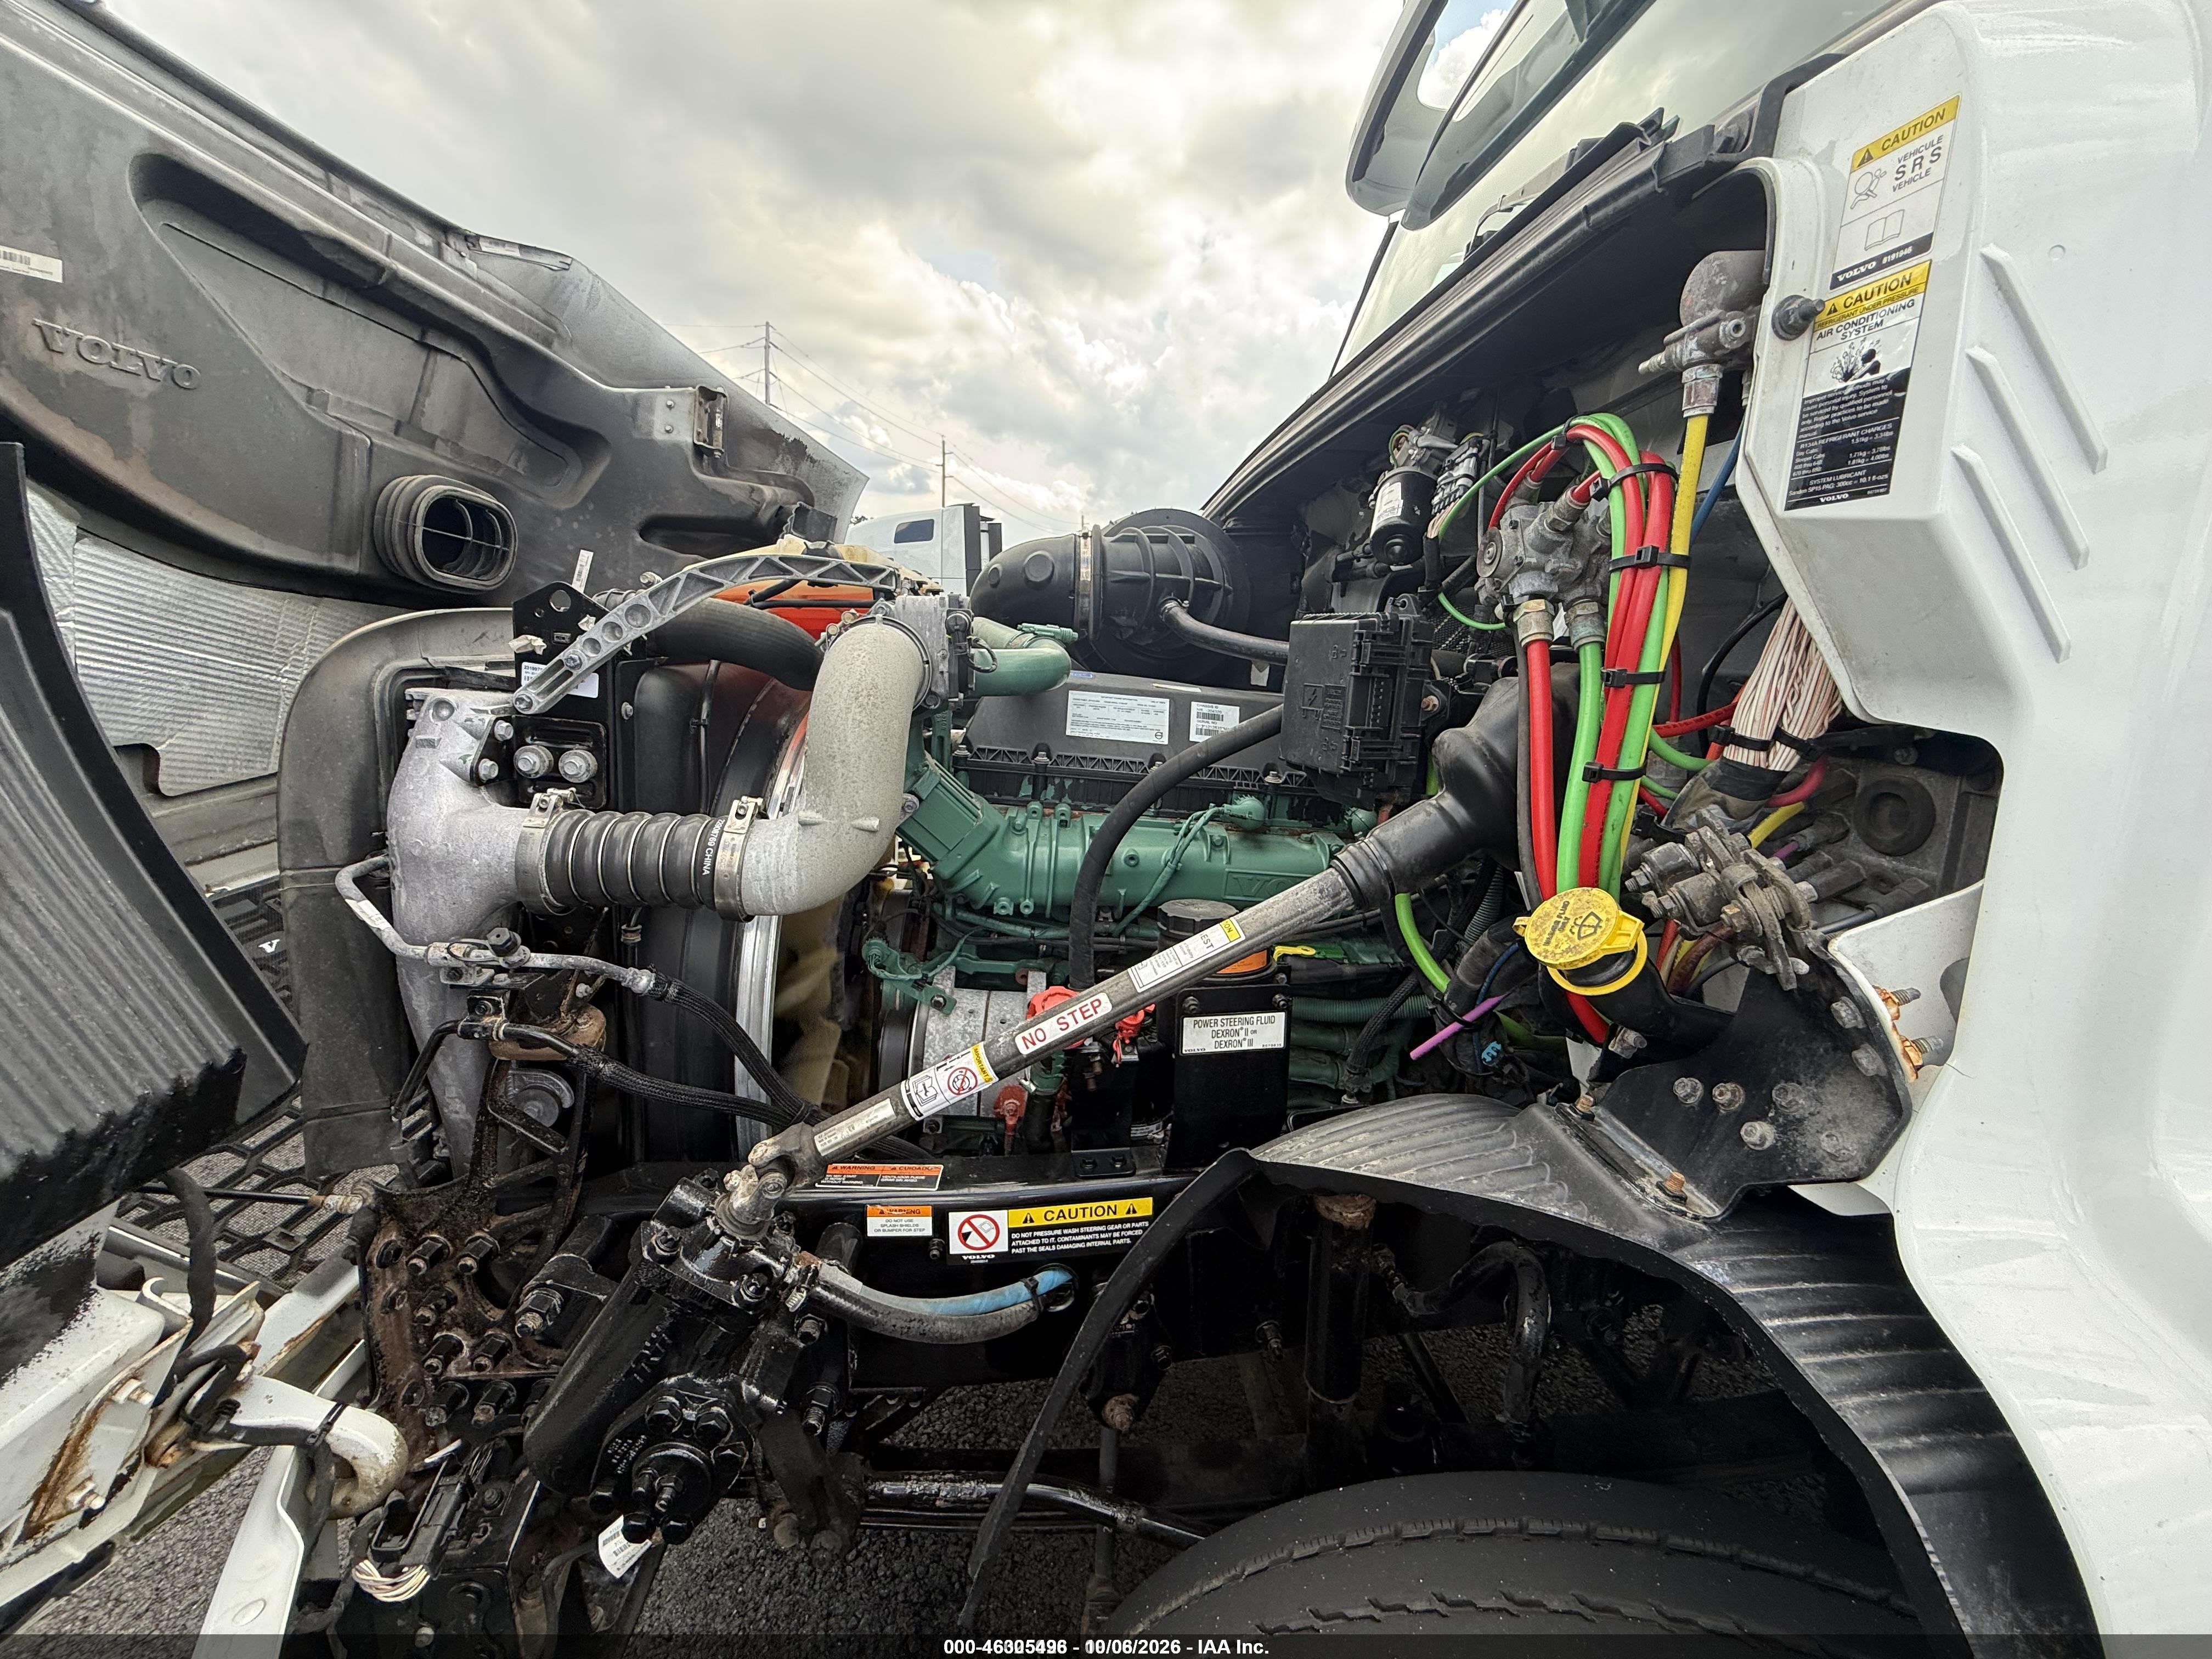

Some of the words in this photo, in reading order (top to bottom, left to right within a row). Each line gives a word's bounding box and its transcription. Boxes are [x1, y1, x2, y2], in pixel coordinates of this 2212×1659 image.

[1882, 109, 1945, 152] CAUTION
[1898, 135, 1944, 163] VEHICULE
[1892, 167, 1931, 192] VEHICLE
[1837, 261, 1876, 281] VOLVO
[1844, 272, 1912, 308] CAUTION
[1818, 309, 1858, 328] REFRIGERANT
[1859, 301, 1882, 313] UNDER
[1883, 287, 1919, 304] PRESSURE
[1817, 328, 1833, 340] AIR
[1836, 299, 1915, 332] CONDITIONING
[1841, 319, 1883, 340] SYSTEM
[32, 318, 201, 390] VOLVO
[1859, 387, 1880, 396] System
[1819, 431, 1859, 444] REFRIGERANT
[1861, 423, 1892, 435] CHARGES
[1810, 477, 1832, 485] SYSTEM
[1833, 470, 1866, 481] LUBRICANT
[1820, 493, 1848, 502] VOLVO
[702, 848, 713, 875] CHINA
[1556, 901, 1570, 918] FLUID
[1022, 1028, 1046, 1049] NO
[1056, 998, 1102, 1031] STEP
[1193, 1019, 1218, 1028] POWER
[1220, 1017, 1254, 1026] STEERING
[1256, 1015, 1275, 1025] FLUID
[1044, 1204, 1118, 1222] CAUTION
[1057, 1234, 1099, 1242] CONTAMINANTS
